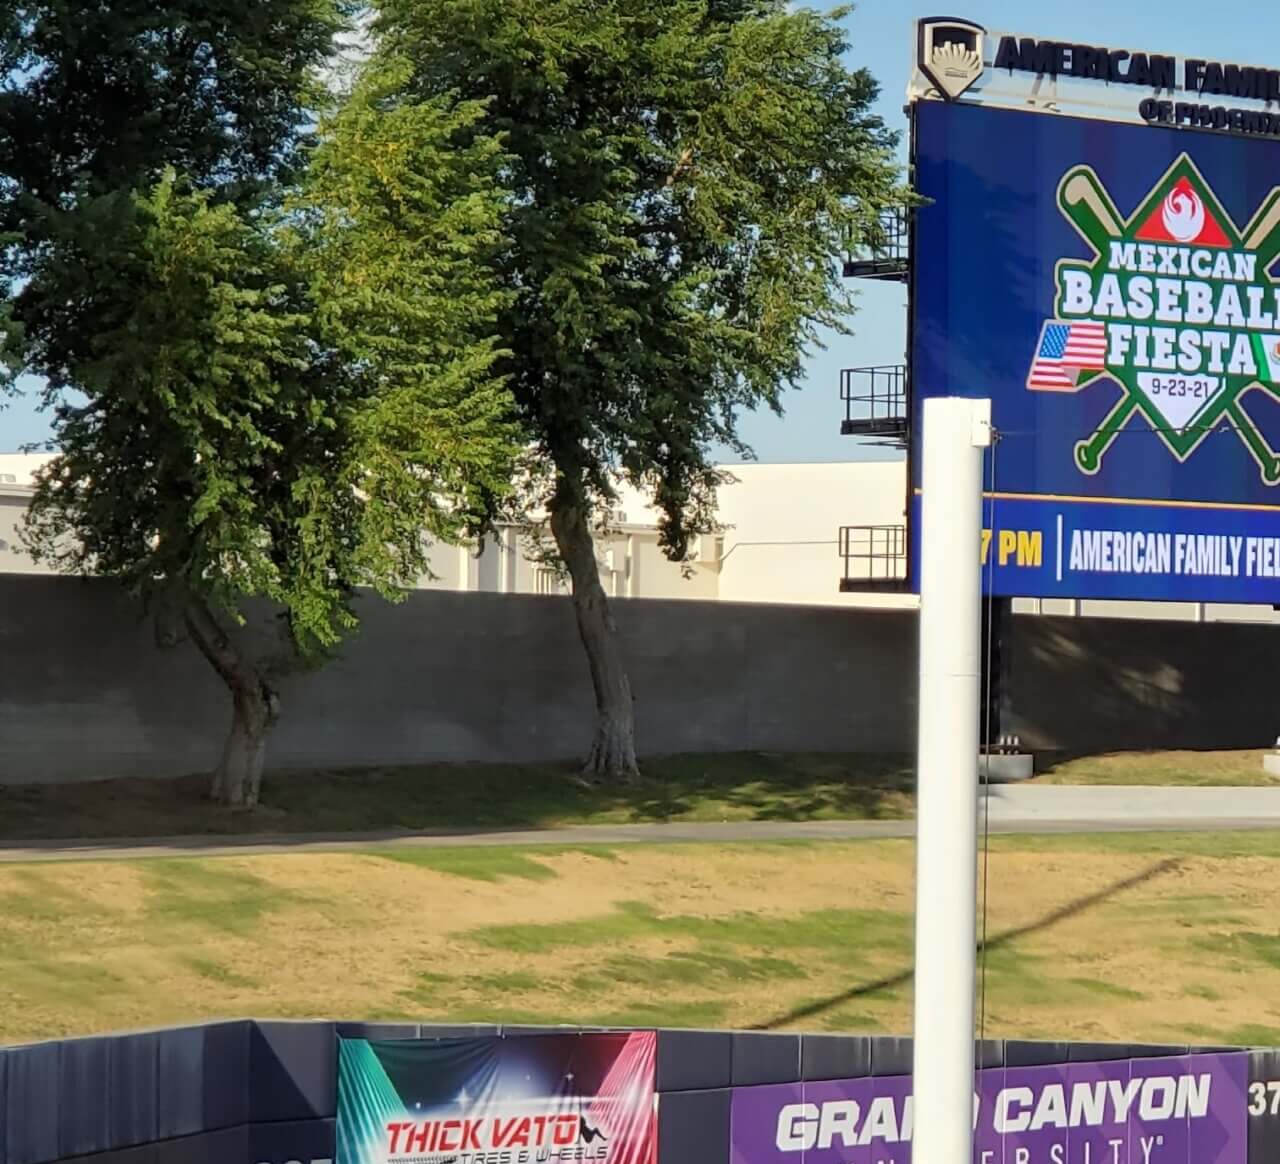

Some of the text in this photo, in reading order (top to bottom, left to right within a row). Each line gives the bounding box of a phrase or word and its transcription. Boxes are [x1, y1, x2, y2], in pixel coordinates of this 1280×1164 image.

[995, 36, 1176, 90] AMERICAN
[1139, 98, 1173, 124] OF
[1108, 241, 1257, 282] MEXICAN
[1107, 323, 1257, 375] FIESTA
[1151, 377, 1209, 399] 9-23-21
[981, 528, 993, 566] 7
[998, 530, 1043, 567] PM
[1069, 529, 1172, 574] AMERICAN
[1174, 533, 1243, 577] FAMILY
[776, 1073, 1212, 1152] GRA CANYON
[386, 1114, 578, 1154] THICK VATO
[536, 1146, 609, 1162] WHEELS
